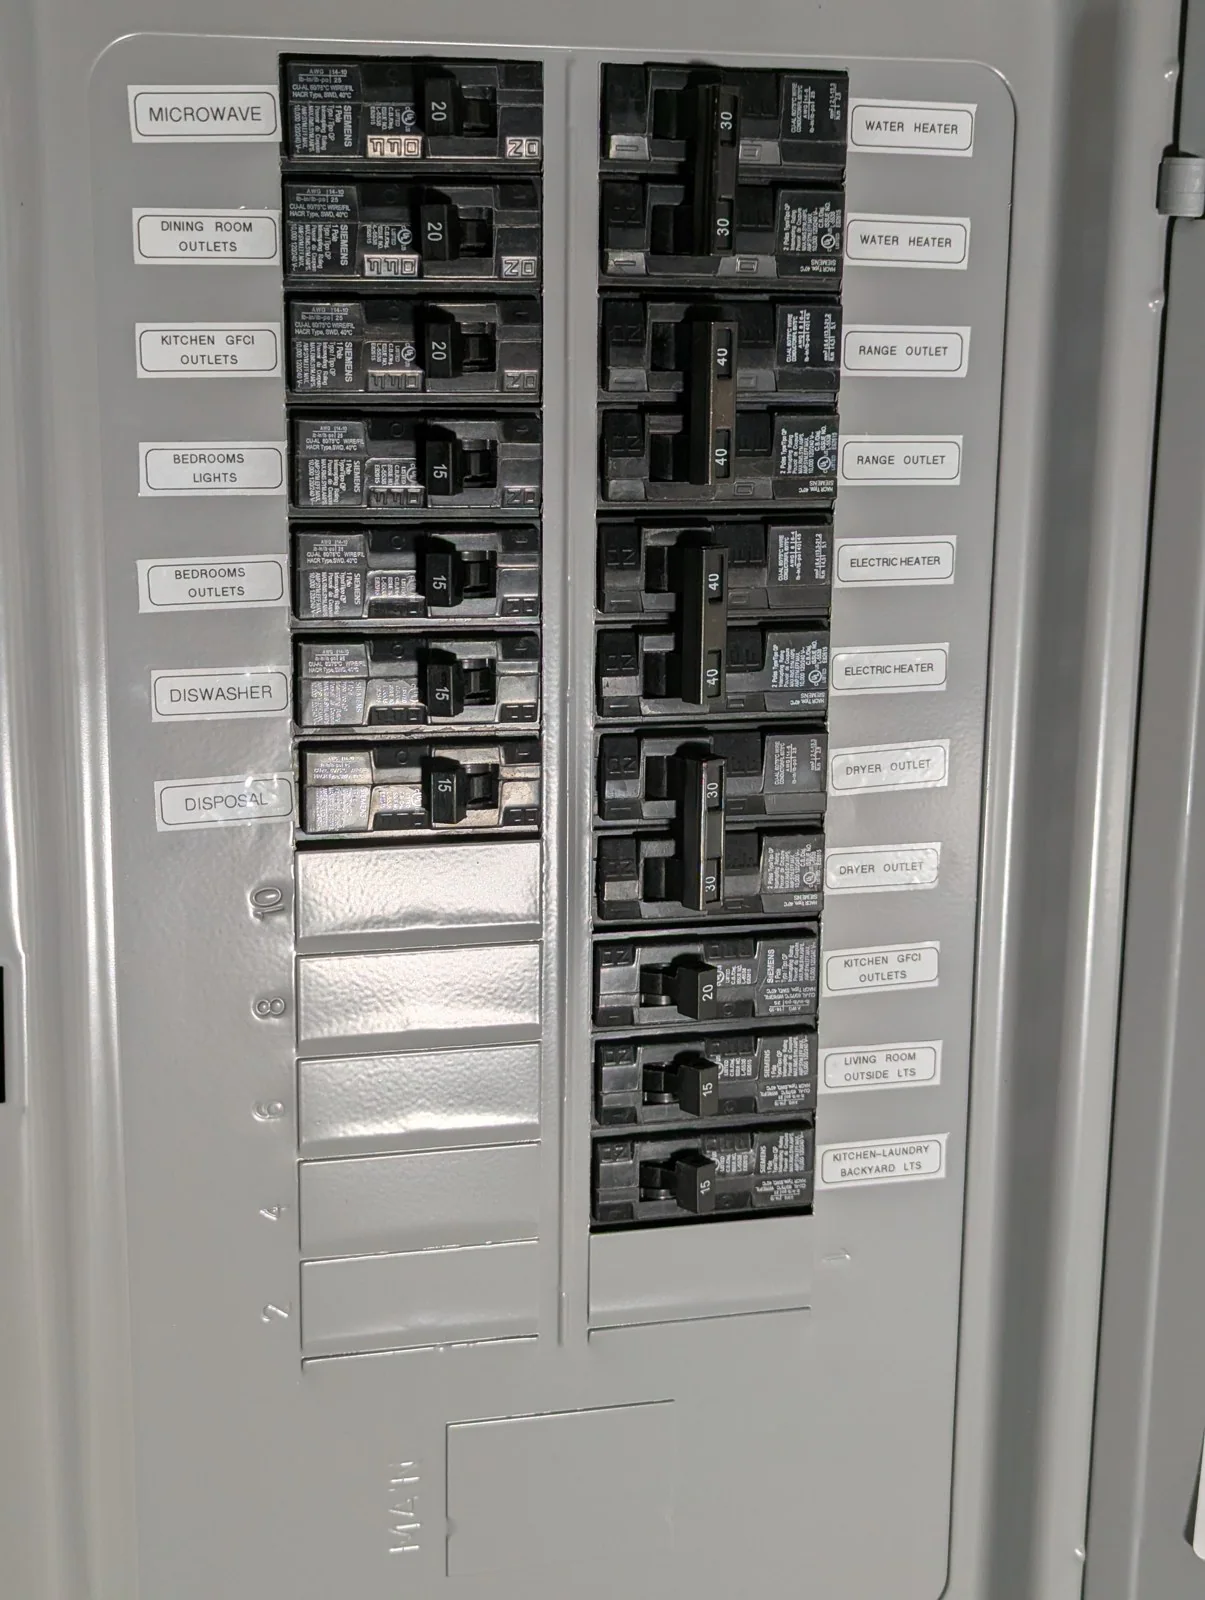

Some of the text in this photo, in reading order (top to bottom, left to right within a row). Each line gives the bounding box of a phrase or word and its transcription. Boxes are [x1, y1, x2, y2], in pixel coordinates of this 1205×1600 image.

[150, 107, 261, 122] MICROWAVE
[431, 101, 447, 122] 20
[344, 105, 352, 147] SIEMENS
[720, 111, 733, 130] 30
[866, 121, 957, 134] WATER HEATER
[161, 221, 252, 232] DINING ROOM
[427, 222, 443, 242] 20
[716, 218, 730, 236] 30
[179, 241, 237, 251] OUTLETS
[340, 225, 348, 266] SIEMENS
[860, 235, 951, 247] WATER HEATER
[161, 335, 254, 345] KITCHEN GFCI
[431, 341, 447, 361] 20
[716, 348, 728, 367] 40
[859, 346, 948, 356] RANGE OUTLET
[181, 355, 238, 364] OUTLETS
[174, 454, 244, 464] BEDROOMS
[715, 448, 728, 466] 40
[857, 456, 945, 464] RANGE OUTLET
[194, 473, 237, 482] LIGHTS
[433, 463, 448, 479] 15
[175, 568, 245, 579] BEDROOMS
[433, 575, 447, 590] 15
[708, 573, 720, 591] 40
[188, 586, 244, 597] OUTLETS
[706, 668, 719, 686] 40
[170, 686, 272, 702] DISWASHER
[435, 686, 449, 701] 15
[846, 759, 931, 775] DRYER OUTLET
[437, 778, 452, 792] 15
[706, 782, 719, 799] 30
[185, 793, 268, 811] DISPOSAL
[840, 862, 923, 875] DRYER OUTLET
[705, 876, 716, 893] 30
[250, 887, 285, 921] 10
[767, 949, 775, 983] SIEMENS
[844, 953, 922, 968] KITCHEN GFCI
[859, 971, 908, 983] OUTLETS
[702, 984, 714, 1002] 20
[252, 997, 286, 1020] 8
[844, 1052, 916, 1065] LIVING ROOM
[844, 1068, 916, 1081] OUTSIDE LTS
[702, 1082, 713, 1097] 15
[833, 1145, 930, 1162] KITCHEN-LAUNDRY
[841, 1161, 921, 1177] BACKYARD LTS
[700, 1180, 711, 1195] 15
